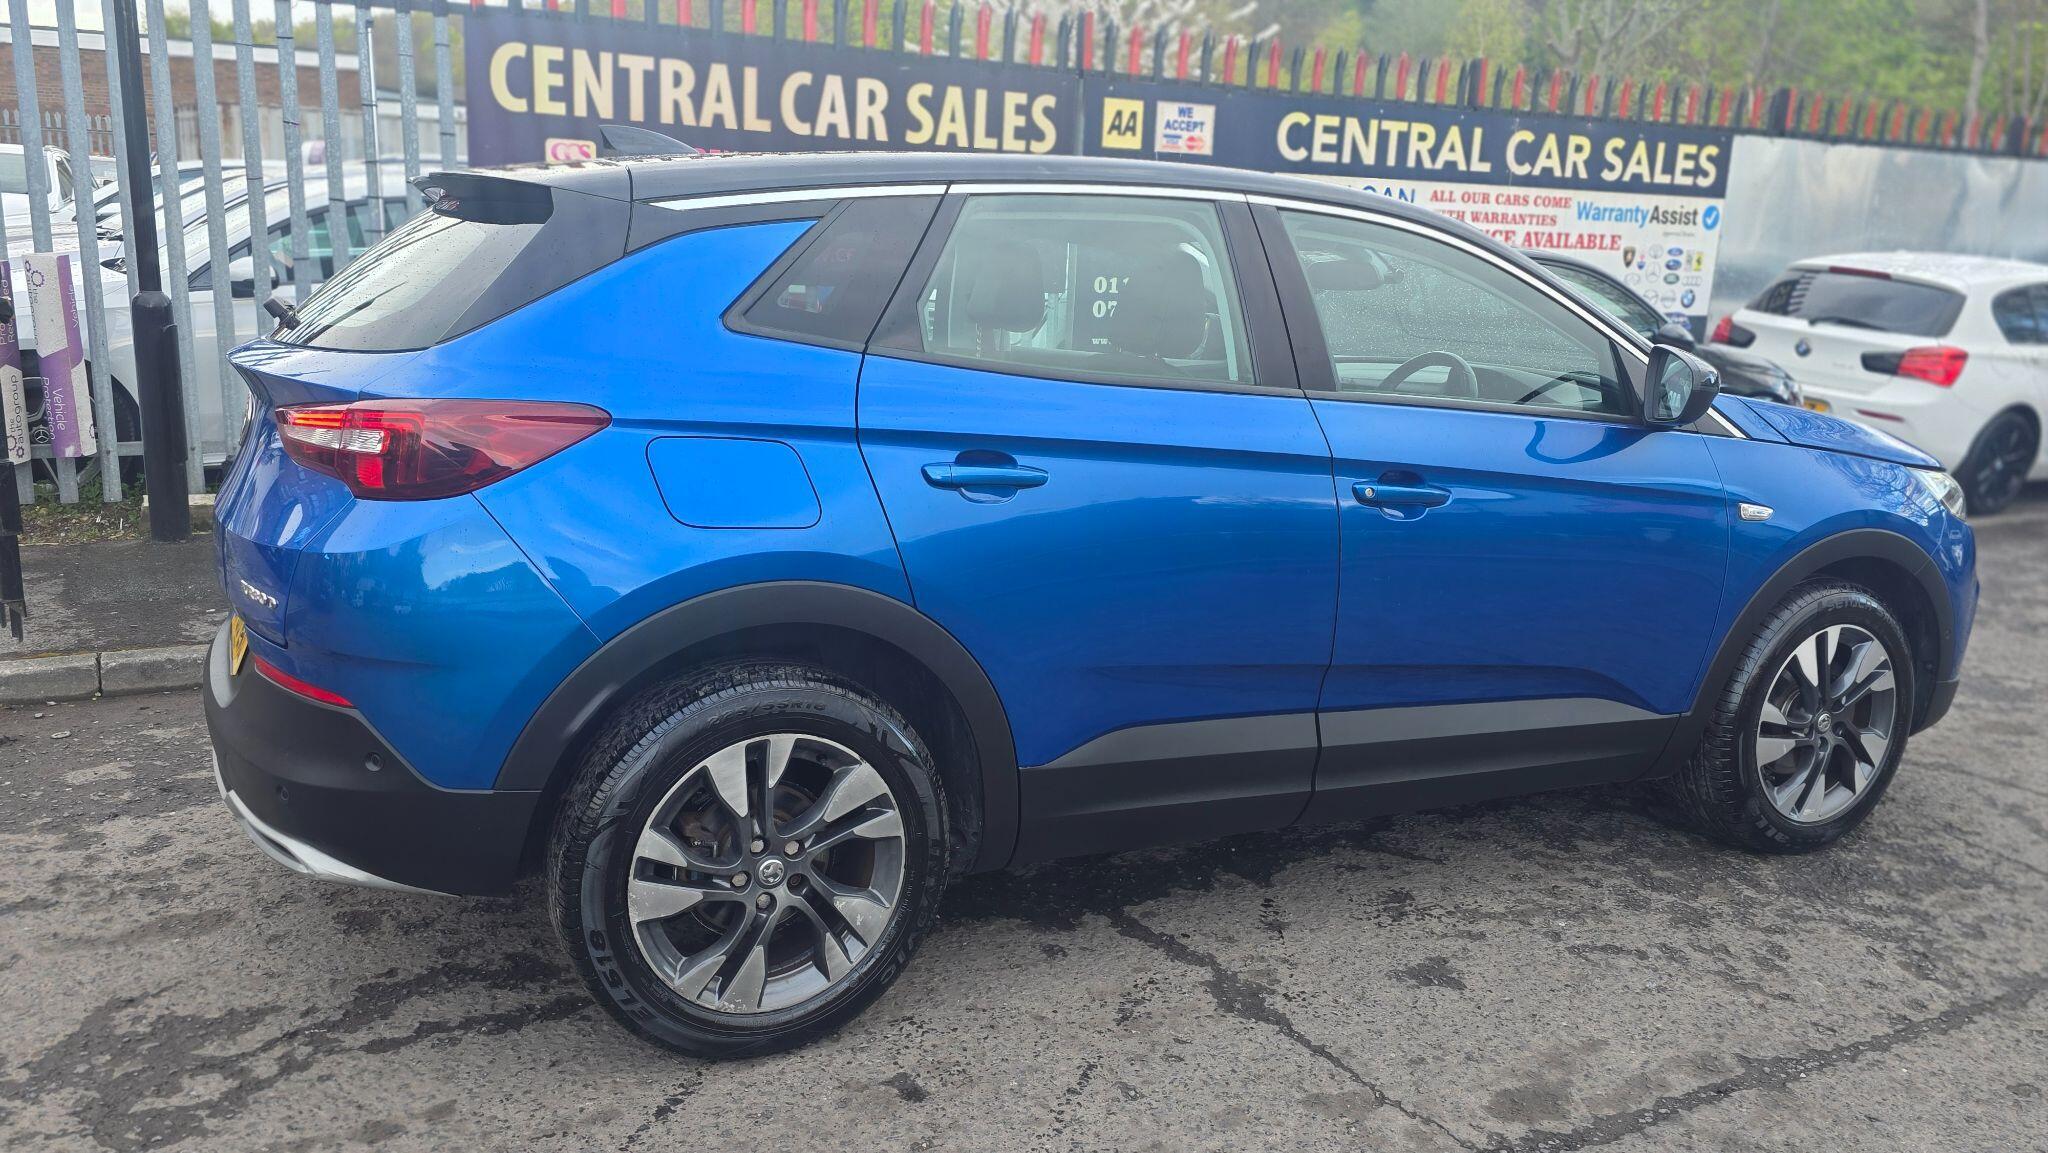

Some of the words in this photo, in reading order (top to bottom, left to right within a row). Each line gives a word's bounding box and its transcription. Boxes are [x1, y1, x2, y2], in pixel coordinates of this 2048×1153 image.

[490, 42, 772, 133] CENTRAL
[779, 71, 889, 141] CAR
[906, 82, 1056, 154] SALES
[1107, 110, 1137, 137] AA
[1178, 106, 1194, 118] WE
[1164, 119, 1205, 132] ACCEPT
[1276, 111, 1491, 172] CENTRAL
[1506, 128, 1590, 178] CAR
[1600, 140, 1719, 187] SALES
[1430, 190, 1456, 203] ALL
[1461, 191, 1490, 204] OUR
[1495, 193, 1530, 207] CARS
[1533, 195, 1572, 209] COME
[1471, 211, 1557, 226] WARRANTIES
[1521, 230, 1622, 251] AVAILABLE
[11, 375, 24, 444] autogroup
[53, 388, 67, 431] Vehicle
